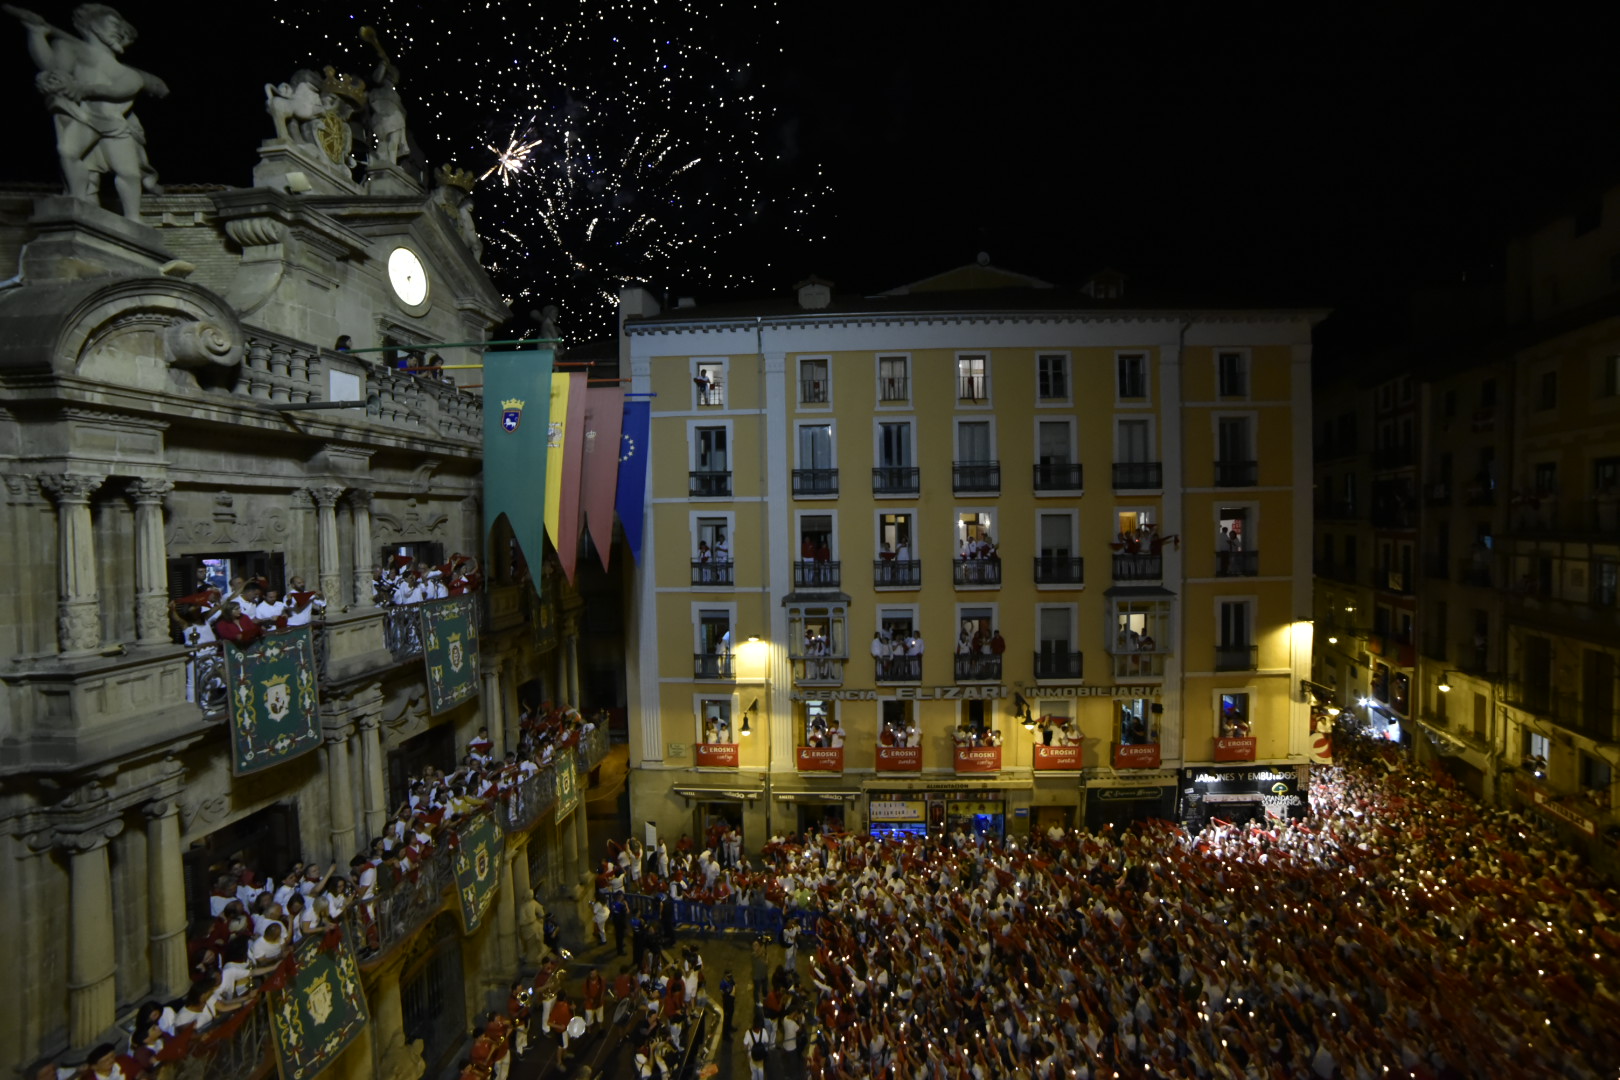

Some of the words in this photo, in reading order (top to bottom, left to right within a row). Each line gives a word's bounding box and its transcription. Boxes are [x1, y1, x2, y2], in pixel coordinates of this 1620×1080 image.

[790, 689, 878, 700] AGENCIA
[895, 686, 1007, 701] ELIZARI
[1025, 686, 1163, 697] INMOBILIARIA
[1238, 773, 1245, 781] Y
